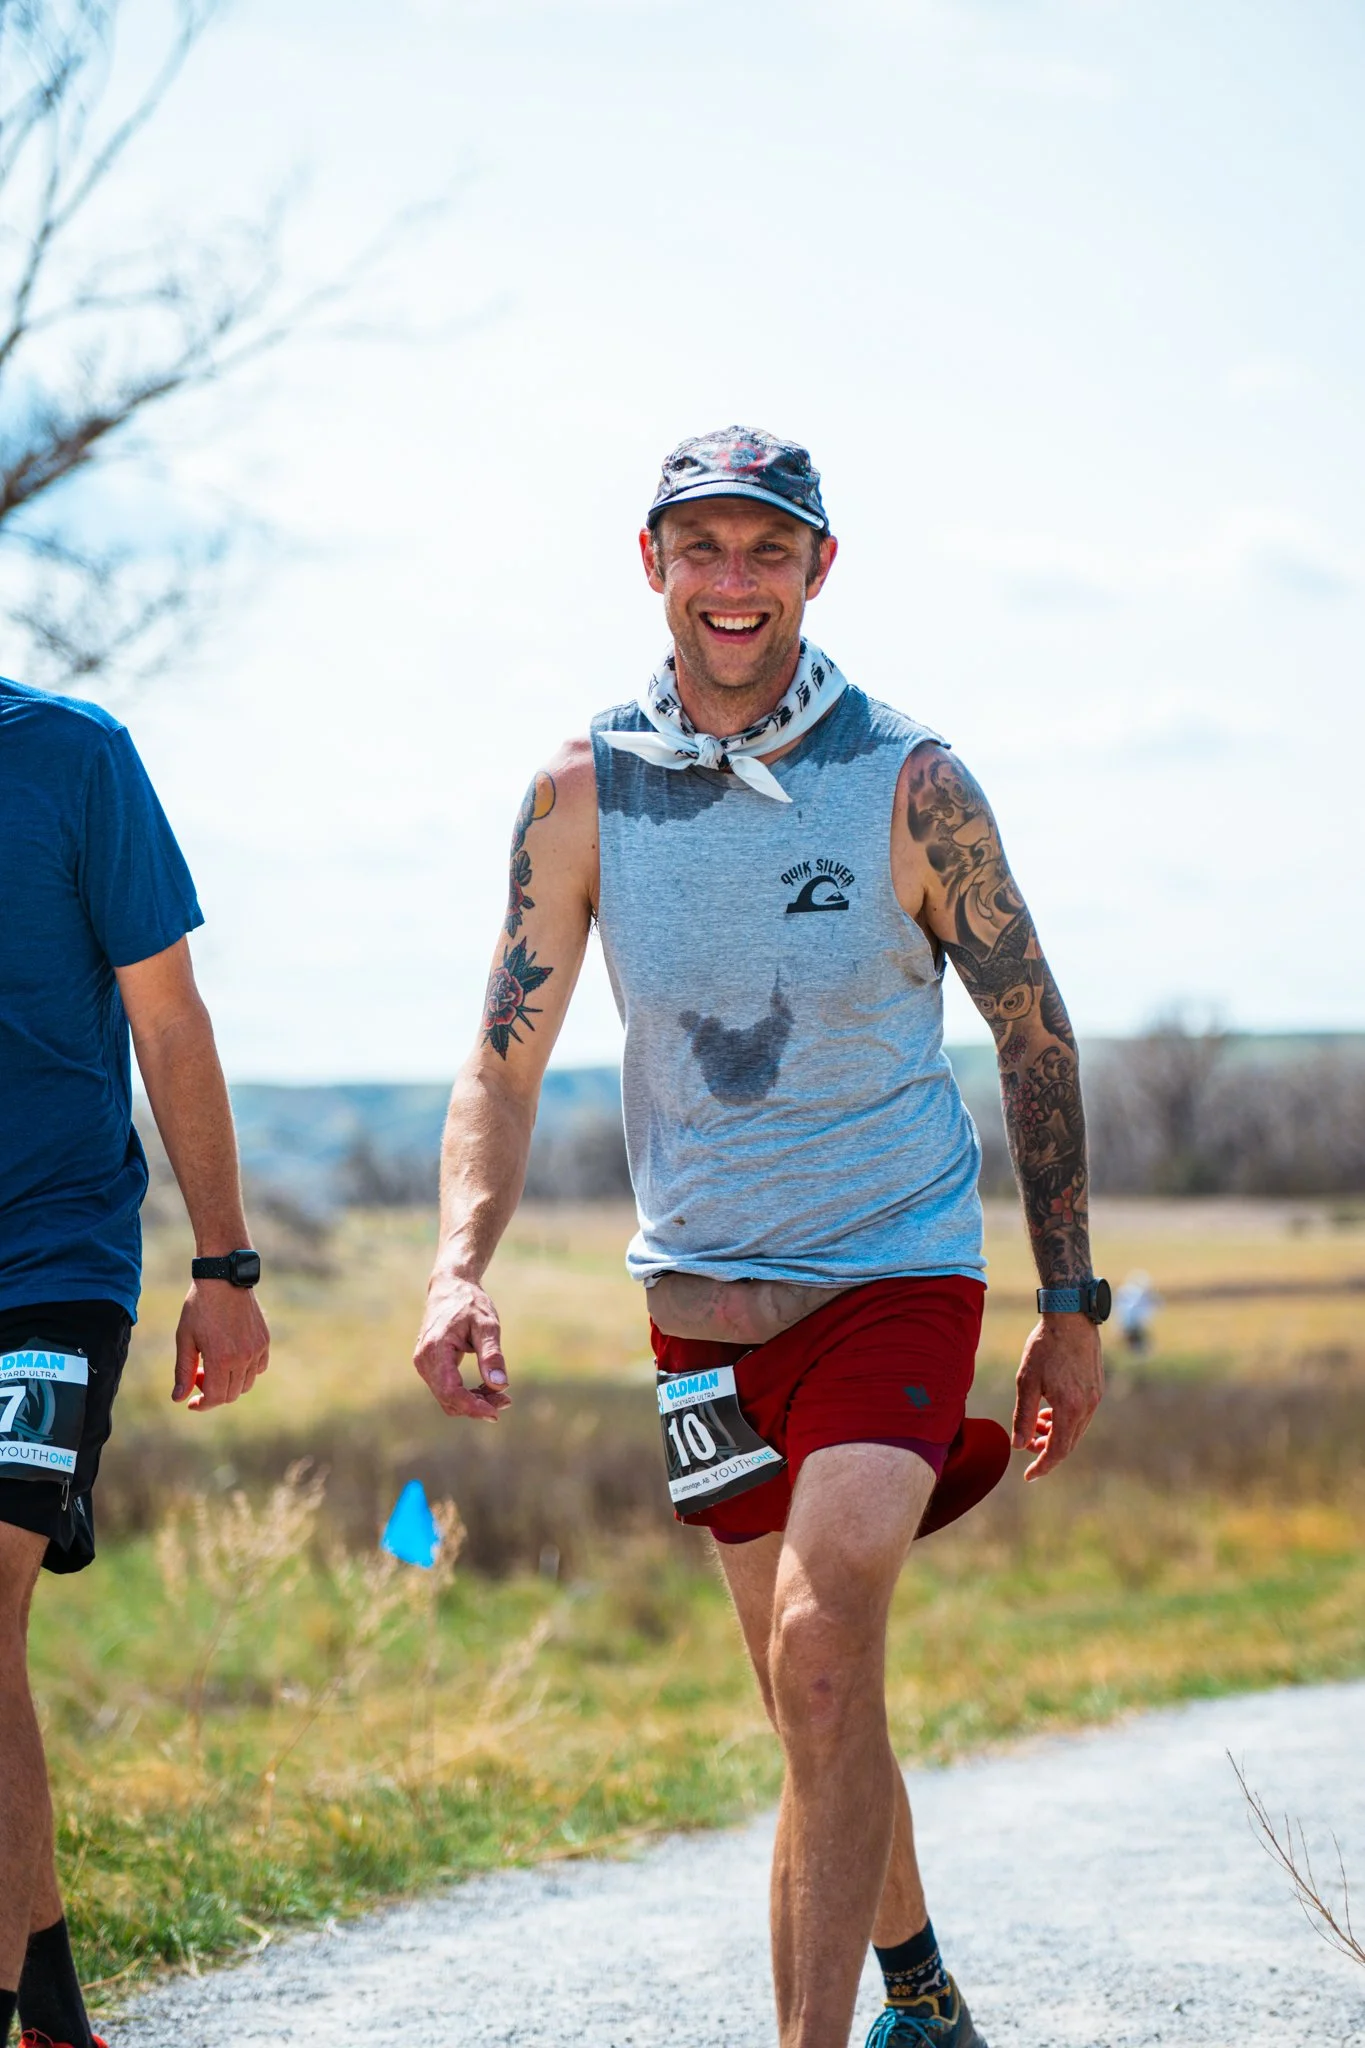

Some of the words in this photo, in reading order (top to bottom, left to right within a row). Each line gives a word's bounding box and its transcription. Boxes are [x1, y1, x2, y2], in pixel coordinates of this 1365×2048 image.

[781, 860, 812, 886] QUIK
[816, 858, 855, 888] SILVER
[0, 1352, 65, 1371] DMAN
[29, 1370, 57, 1379] ULTRA
[667, 1371, 719, 1400] OLDMAN
[697, 1391, 715, 1401] ULTRA
[0, 1385, 26, 1433] 7
[668, 1412, 717, 1467] 10
[711, 1451, 775, 1481] YOUTHONE
